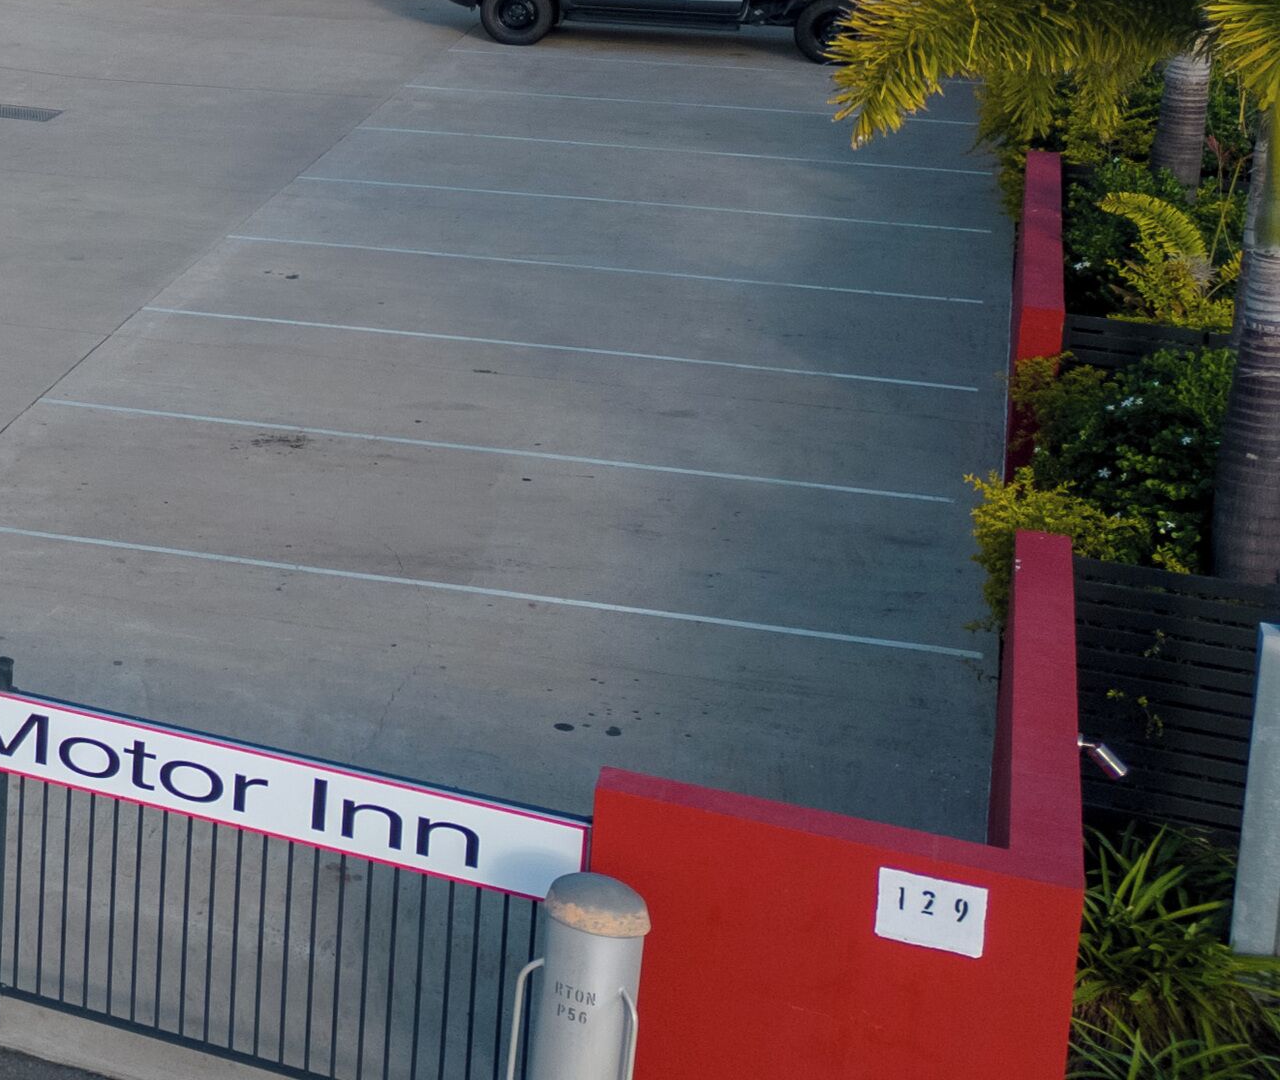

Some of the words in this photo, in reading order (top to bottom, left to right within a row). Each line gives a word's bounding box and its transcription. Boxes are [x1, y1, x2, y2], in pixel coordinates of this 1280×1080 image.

[311, 777, 480, 869] Inn
[555, 981, 596, 1006] RTON
[557, 1003, 587, 1024] P56
